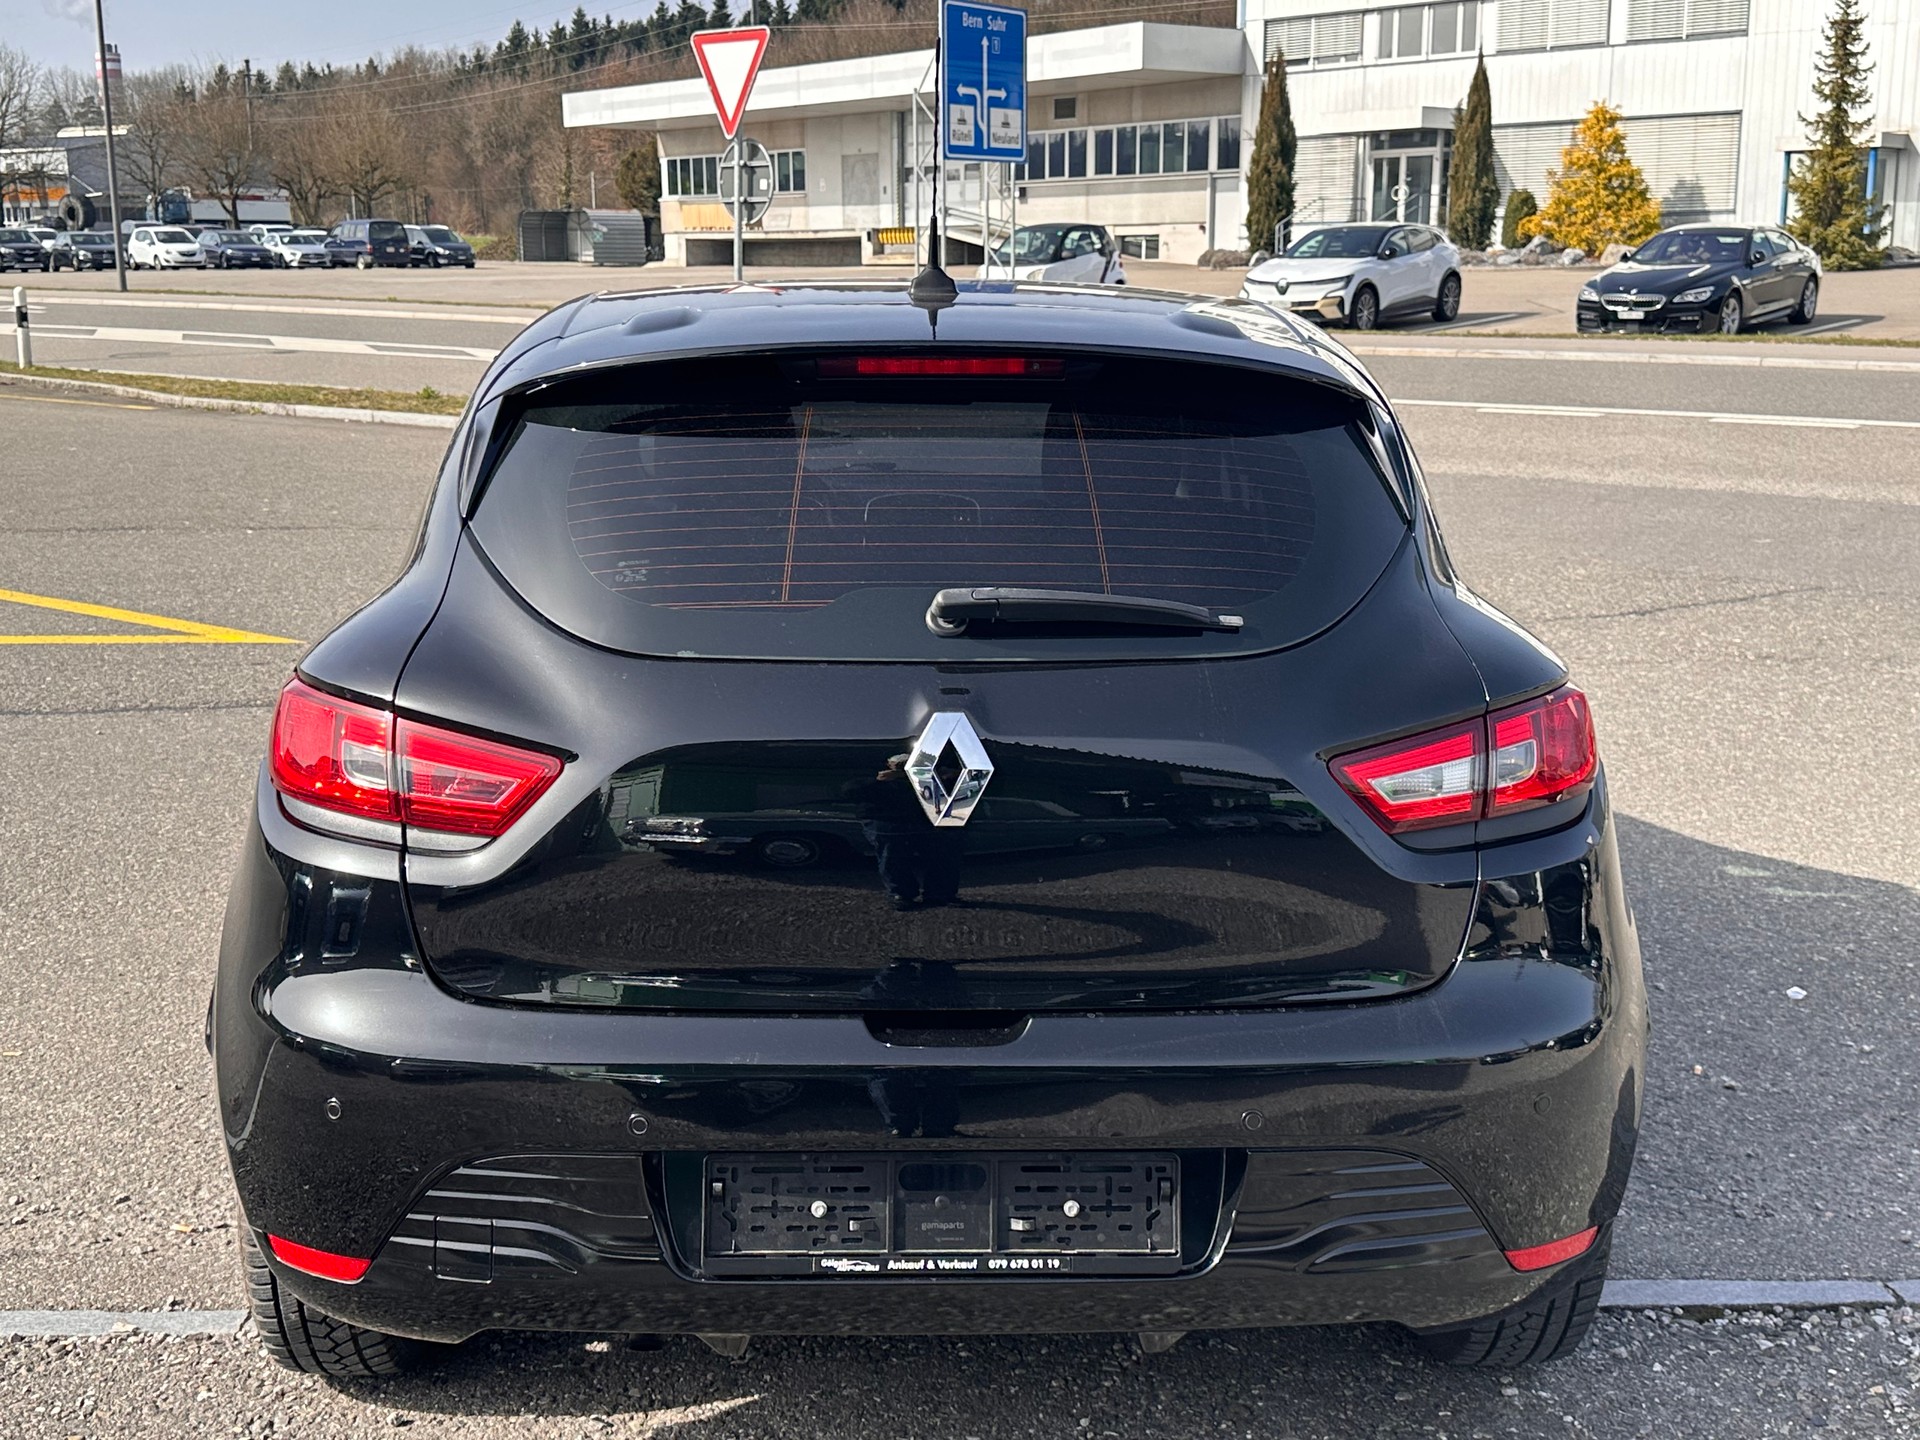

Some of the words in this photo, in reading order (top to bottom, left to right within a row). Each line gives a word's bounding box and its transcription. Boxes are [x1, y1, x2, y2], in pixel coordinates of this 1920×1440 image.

[962, 11, 983, 29] Bern
[987, 15, 1007, 32] Suhr
[921, 1221, 965, 1231] gamaparts
[887, 1259, 925, 1270] Ankauf
[926, 1259, 936, 1270] &
[937, 1259, 978, 1270] Verkauf
[988, 1258, 1008, 1270] 079
[1009, 1258, 1030, 1270] 678
[1031, 1258, 1044, 1270] 01
[1047, 1258, 1060, 1270] 19
